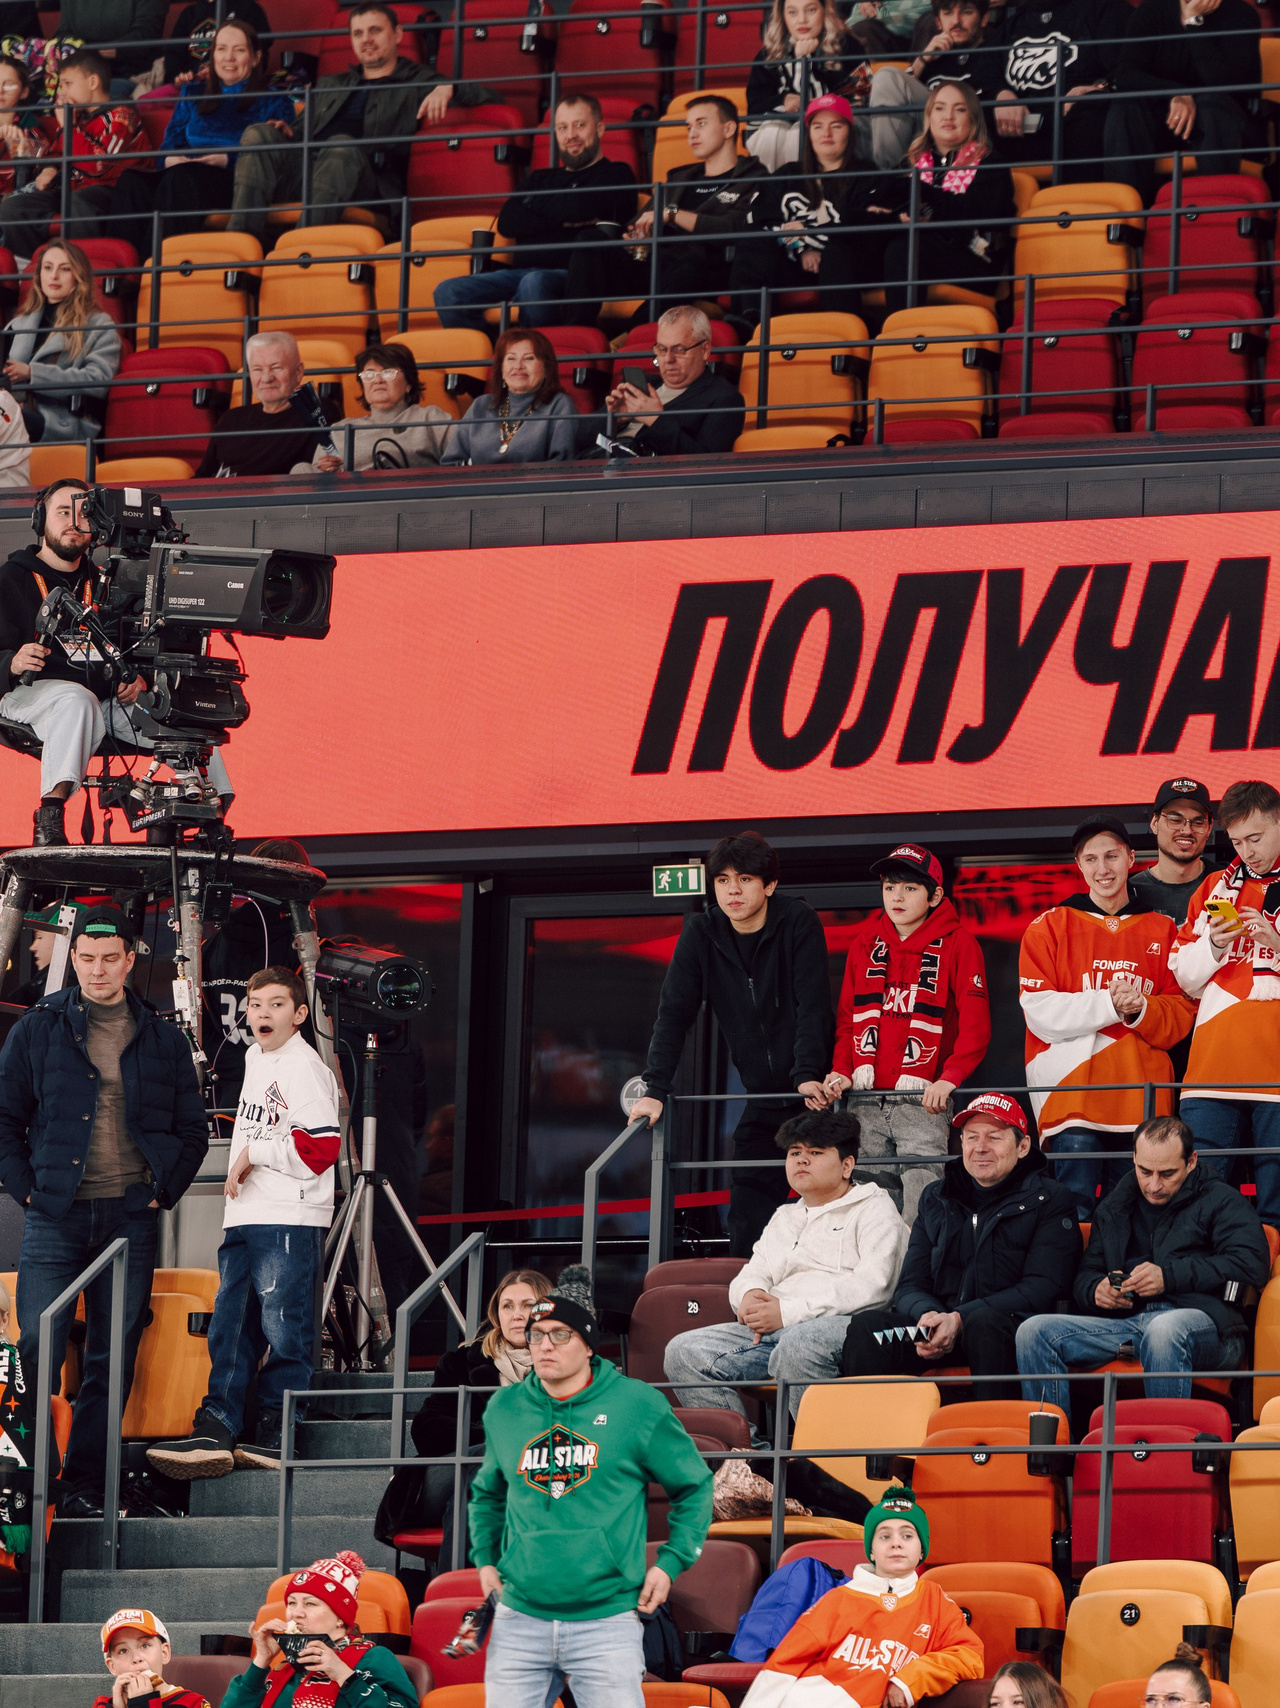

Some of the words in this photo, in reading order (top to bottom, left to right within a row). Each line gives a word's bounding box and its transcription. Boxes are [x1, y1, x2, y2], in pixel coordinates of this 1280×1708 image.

[122, 510, 145, 519] SONY
[227, 580, 245, 590] Canon
[178, 597, 198, 606] DIGISUPER
[197, 598, 206, 606] 122
[195, 700, 216, 709] Vinten
[1092, 959, 1139, 972] FONBET
[1020, 977, 1044, 989] BET
[687, 1301, 699, 1314] 29
[520, 1448, 551, 1471] ALL
[554, 1444, 598, 1468] STAR
[1123, 1609, 1136, 1618] 21
[833, 1633, 873, 1665] ALL
